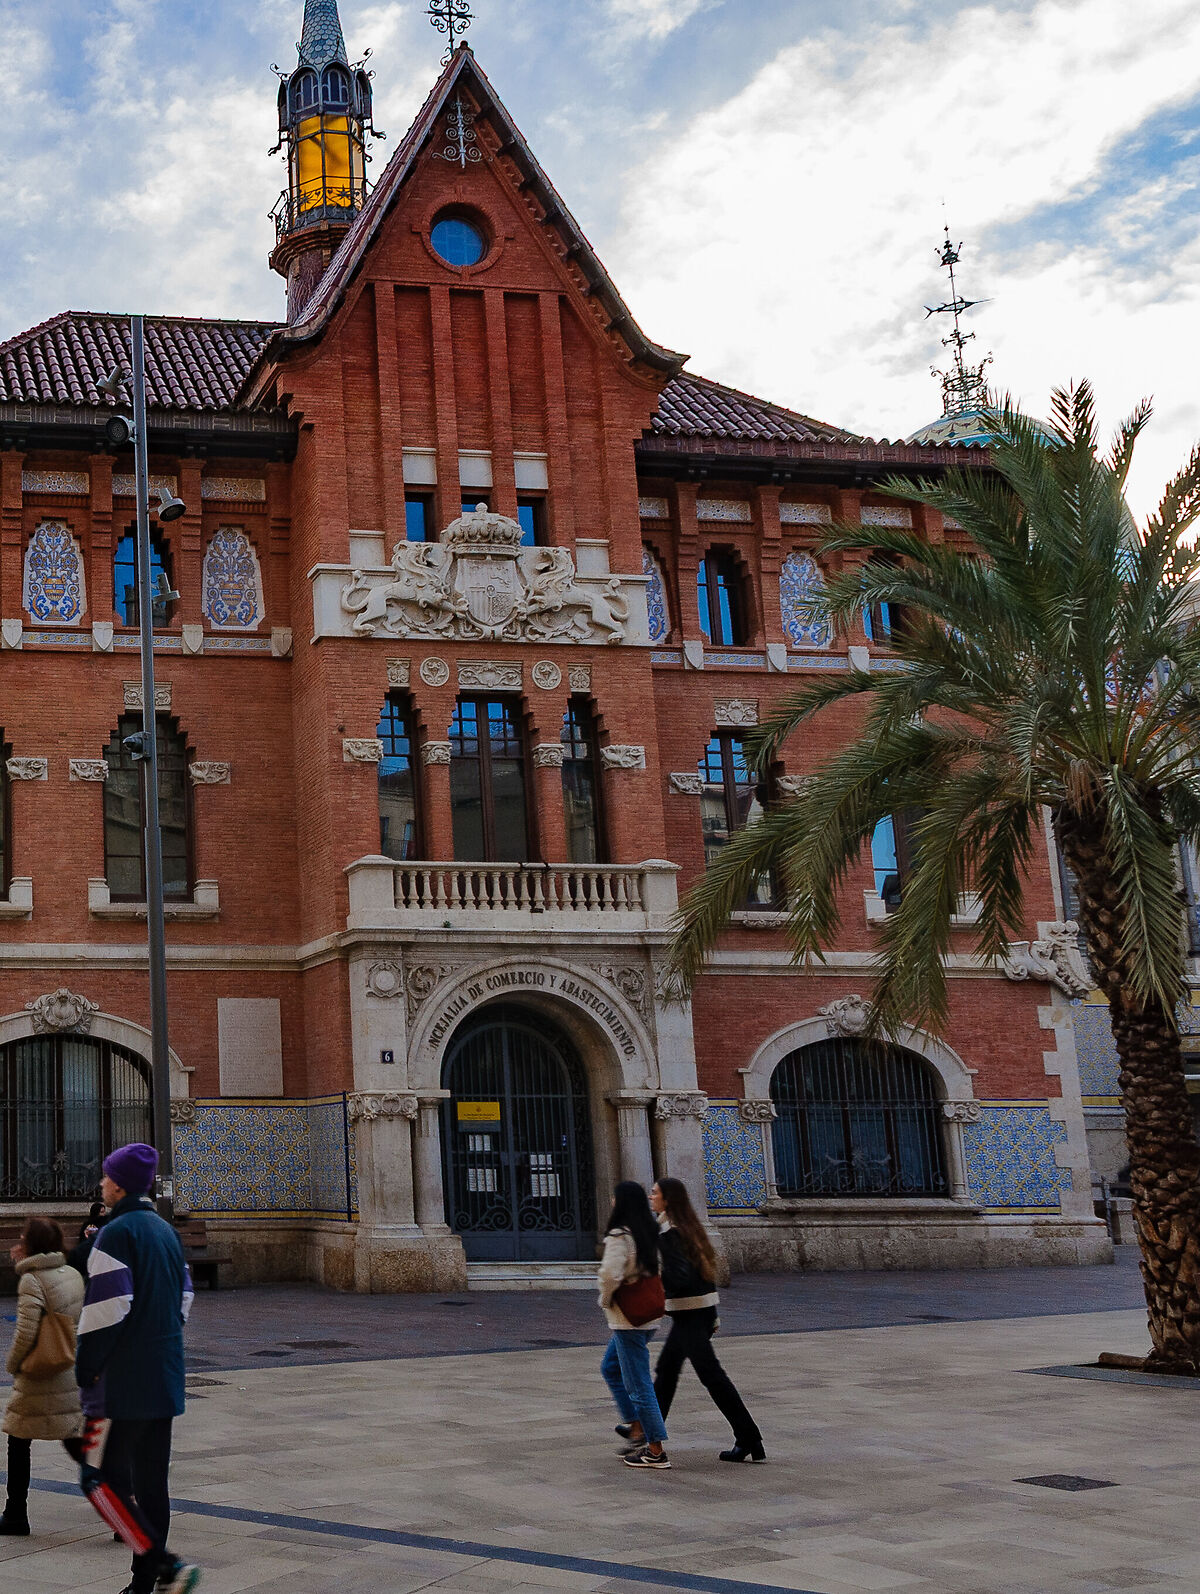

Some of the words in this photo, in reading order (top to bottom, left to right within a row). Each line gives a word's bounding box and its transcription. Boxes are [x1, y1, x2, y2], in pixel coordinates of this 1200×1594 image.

[425, 996, 469, 1053] NCEJALIA
[467, 982, 483, 1001] DE
[486, 971, 544, 991] COMERCIO
[549, 975, 557, 988] Y
[560, 978, 637, 1056] ABASTECIMIENTO
[384, 1052, 391, 1062] 6
